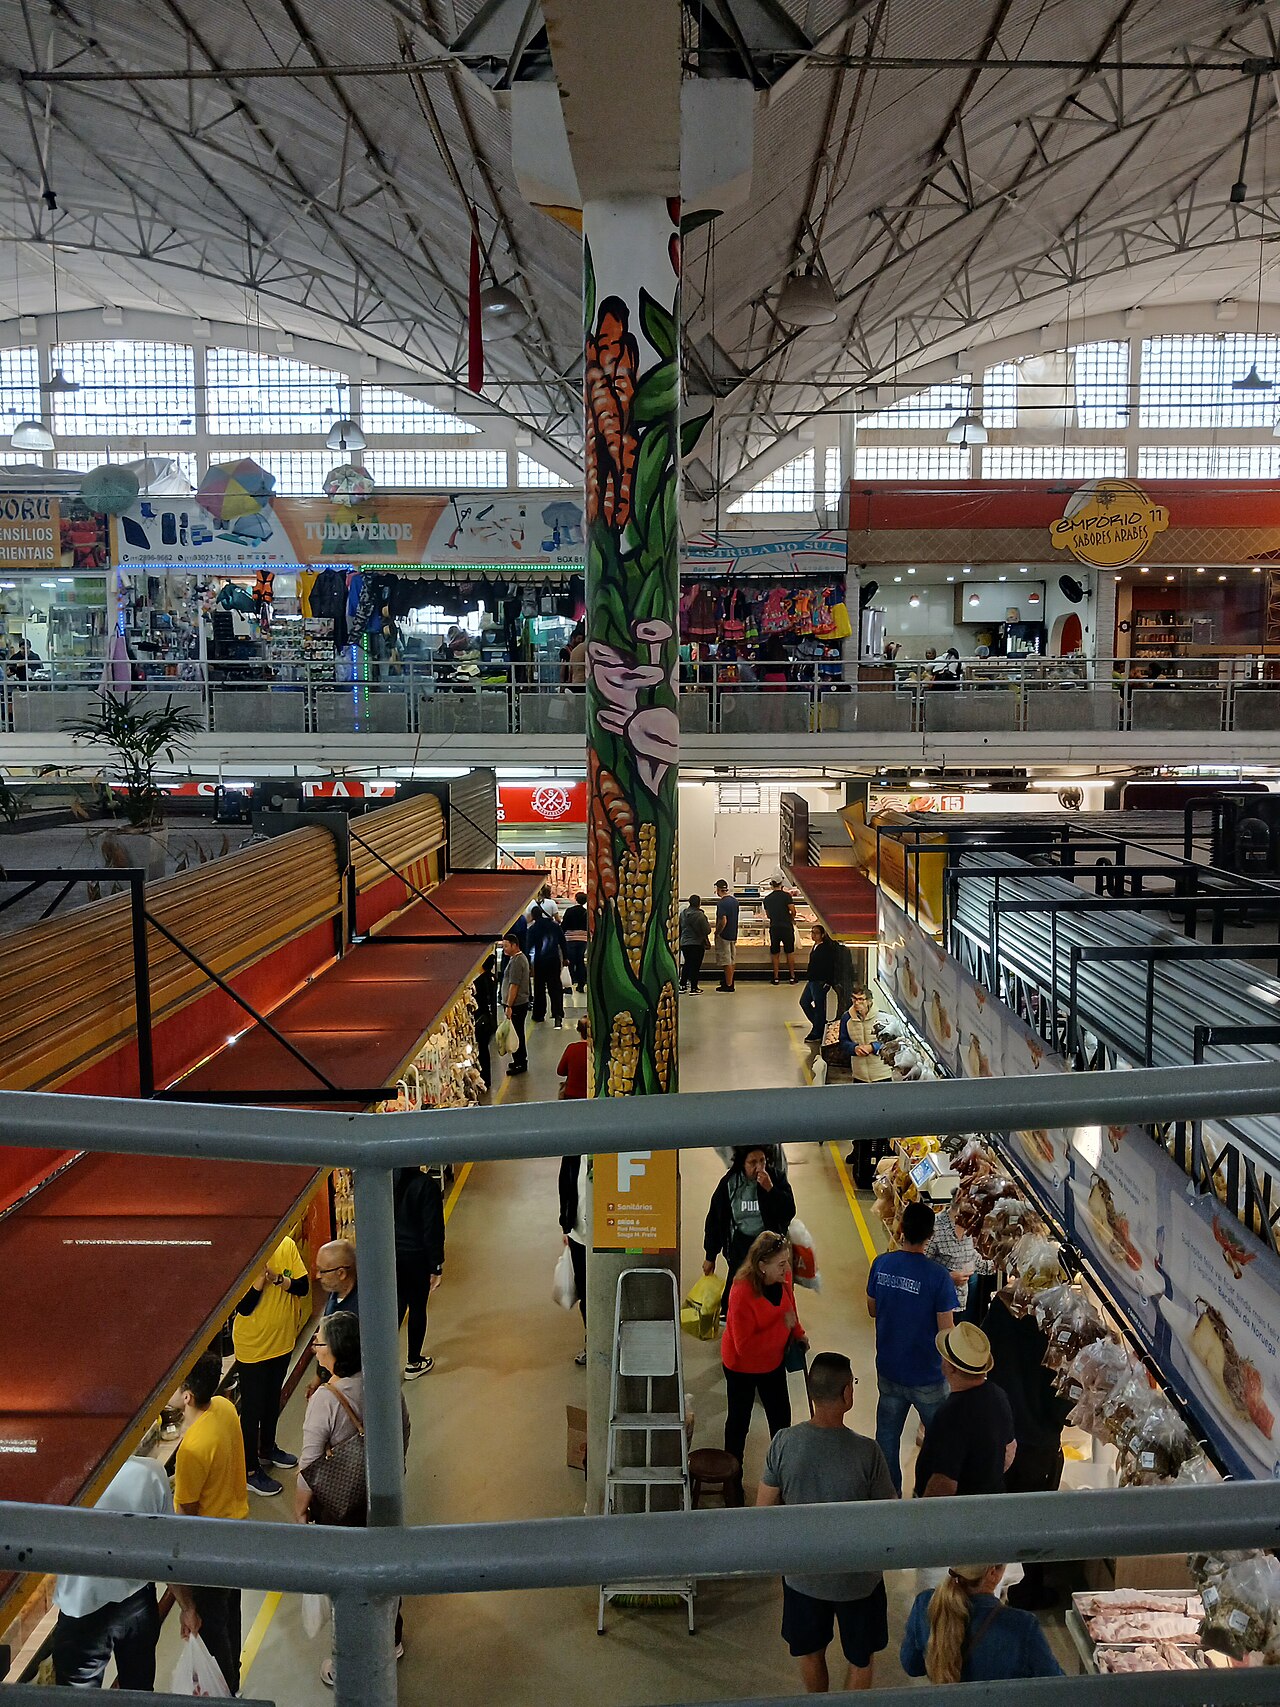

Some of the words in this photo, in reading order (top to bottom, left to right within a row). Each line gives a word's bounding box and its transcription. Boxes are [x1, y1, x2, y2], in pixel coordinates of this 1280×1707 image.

[1149, 509, 1162, 522] 11
[304, 522, 351, 540] TUDO
[355, 522, 412, 540] VERDE
[1073, 530, 1112, 549] SABORES
[1114, 524, 1148, 543] ÁRABES
[775, 542, 798, 552] DO
[803, 540, 836, 551] SUL
[943, 796, 960, 811] 15
[617, 1150, 652, 1193] F
[617, 1203, 653, 1211] Sanitários
[741, 1200, 760, 1212] PUM
